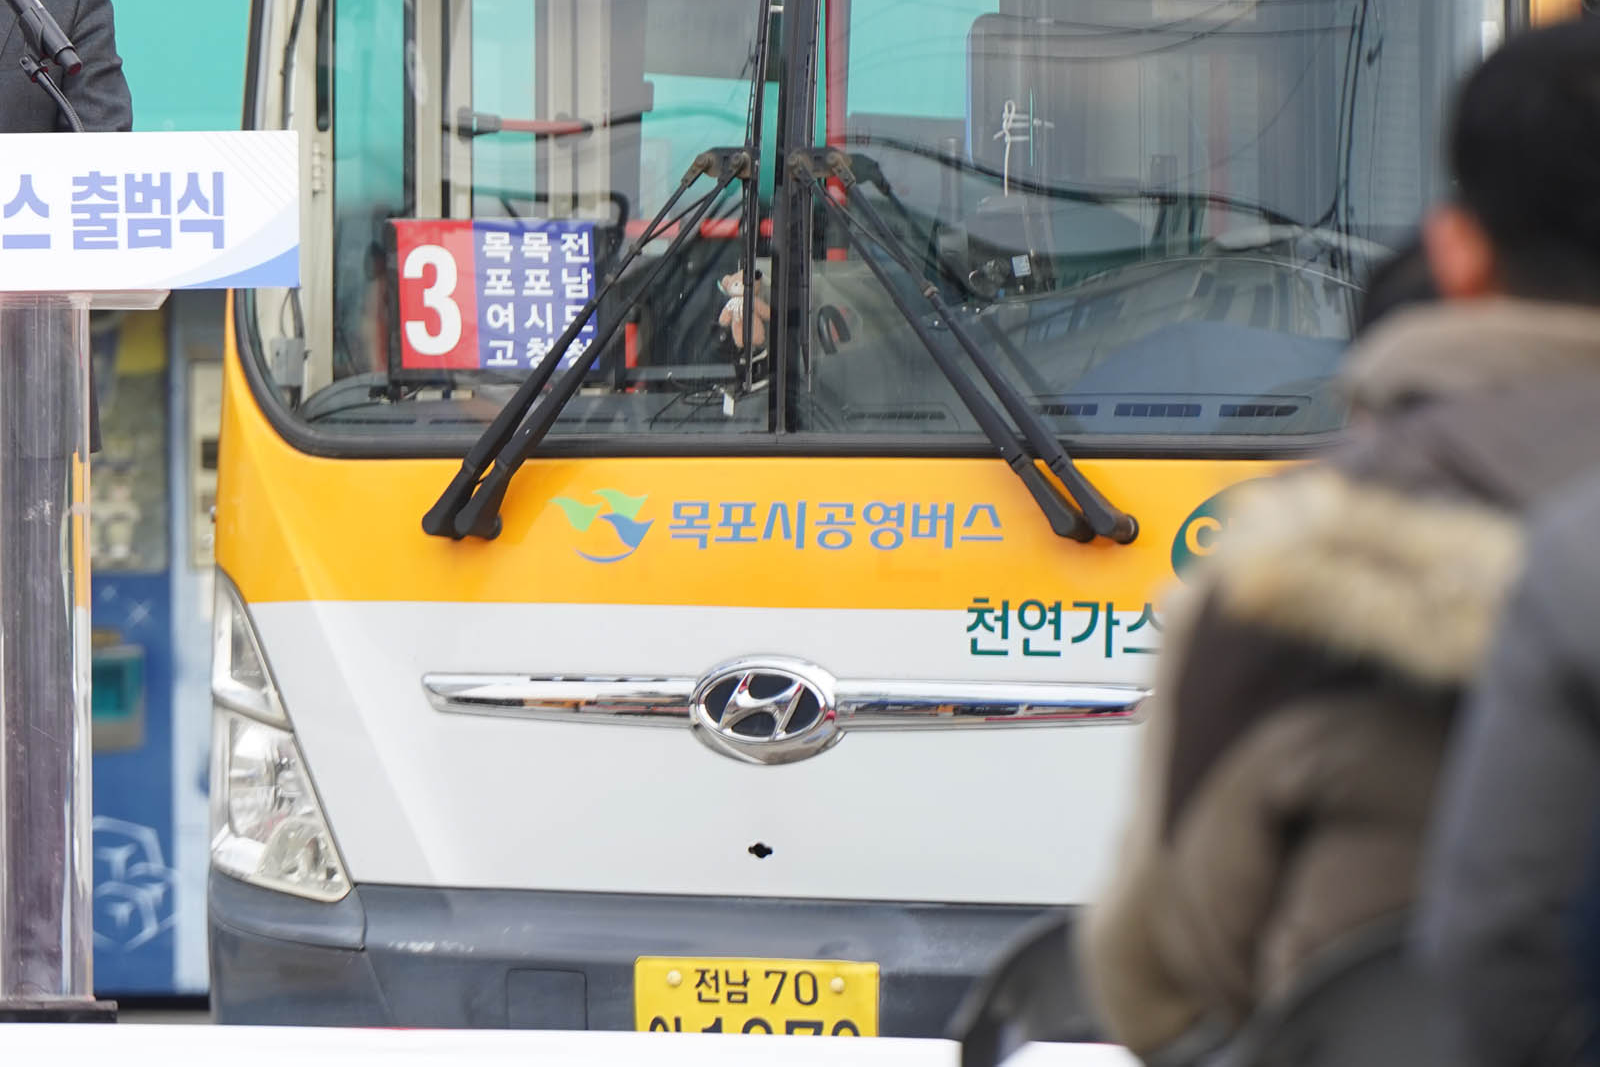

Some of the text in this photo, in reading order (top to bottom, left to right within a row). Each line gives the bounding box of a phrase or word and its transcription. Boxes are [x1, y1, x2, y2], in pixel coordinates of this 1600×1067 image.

[69, 170, 226, 251] 출범식
[402, 244, 463, 356] 3
[482, 230, 518, 367] 목포여고
[667, 498, 1005, 552] 목포시공영버스
[693, 967, 820, 1007] 전남 70
